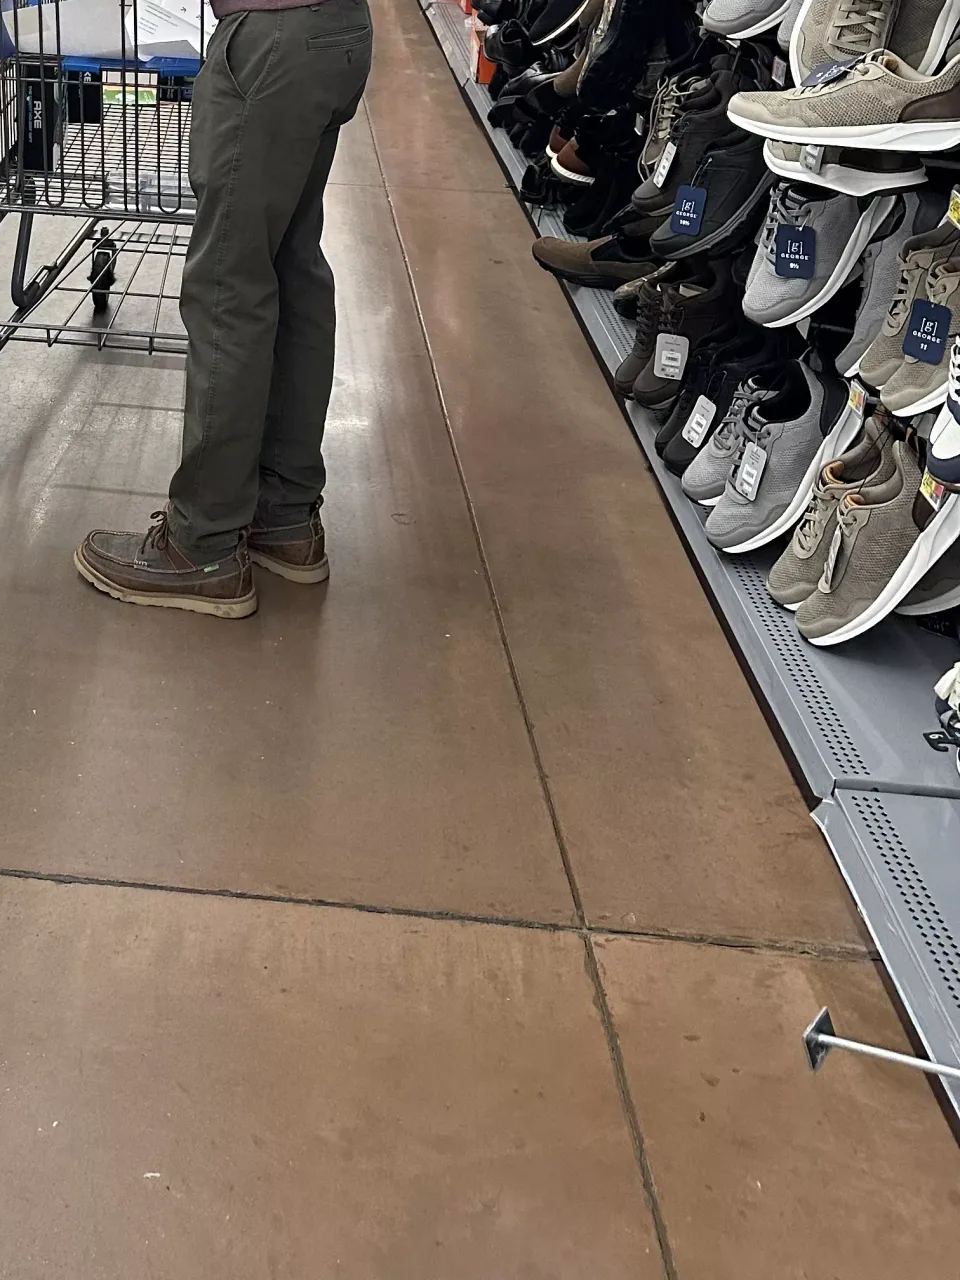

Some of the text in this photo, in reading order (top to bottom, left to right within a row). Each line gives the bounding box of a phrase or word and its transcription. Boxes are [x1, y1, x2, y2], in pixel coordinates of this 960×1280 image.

[33, 100, 42, 129] AXE
[675, 210, 698, 219] GEORGE
[780, 253, 809, 261] GEORGE
[912, 330, 941, 344] GEORGE
